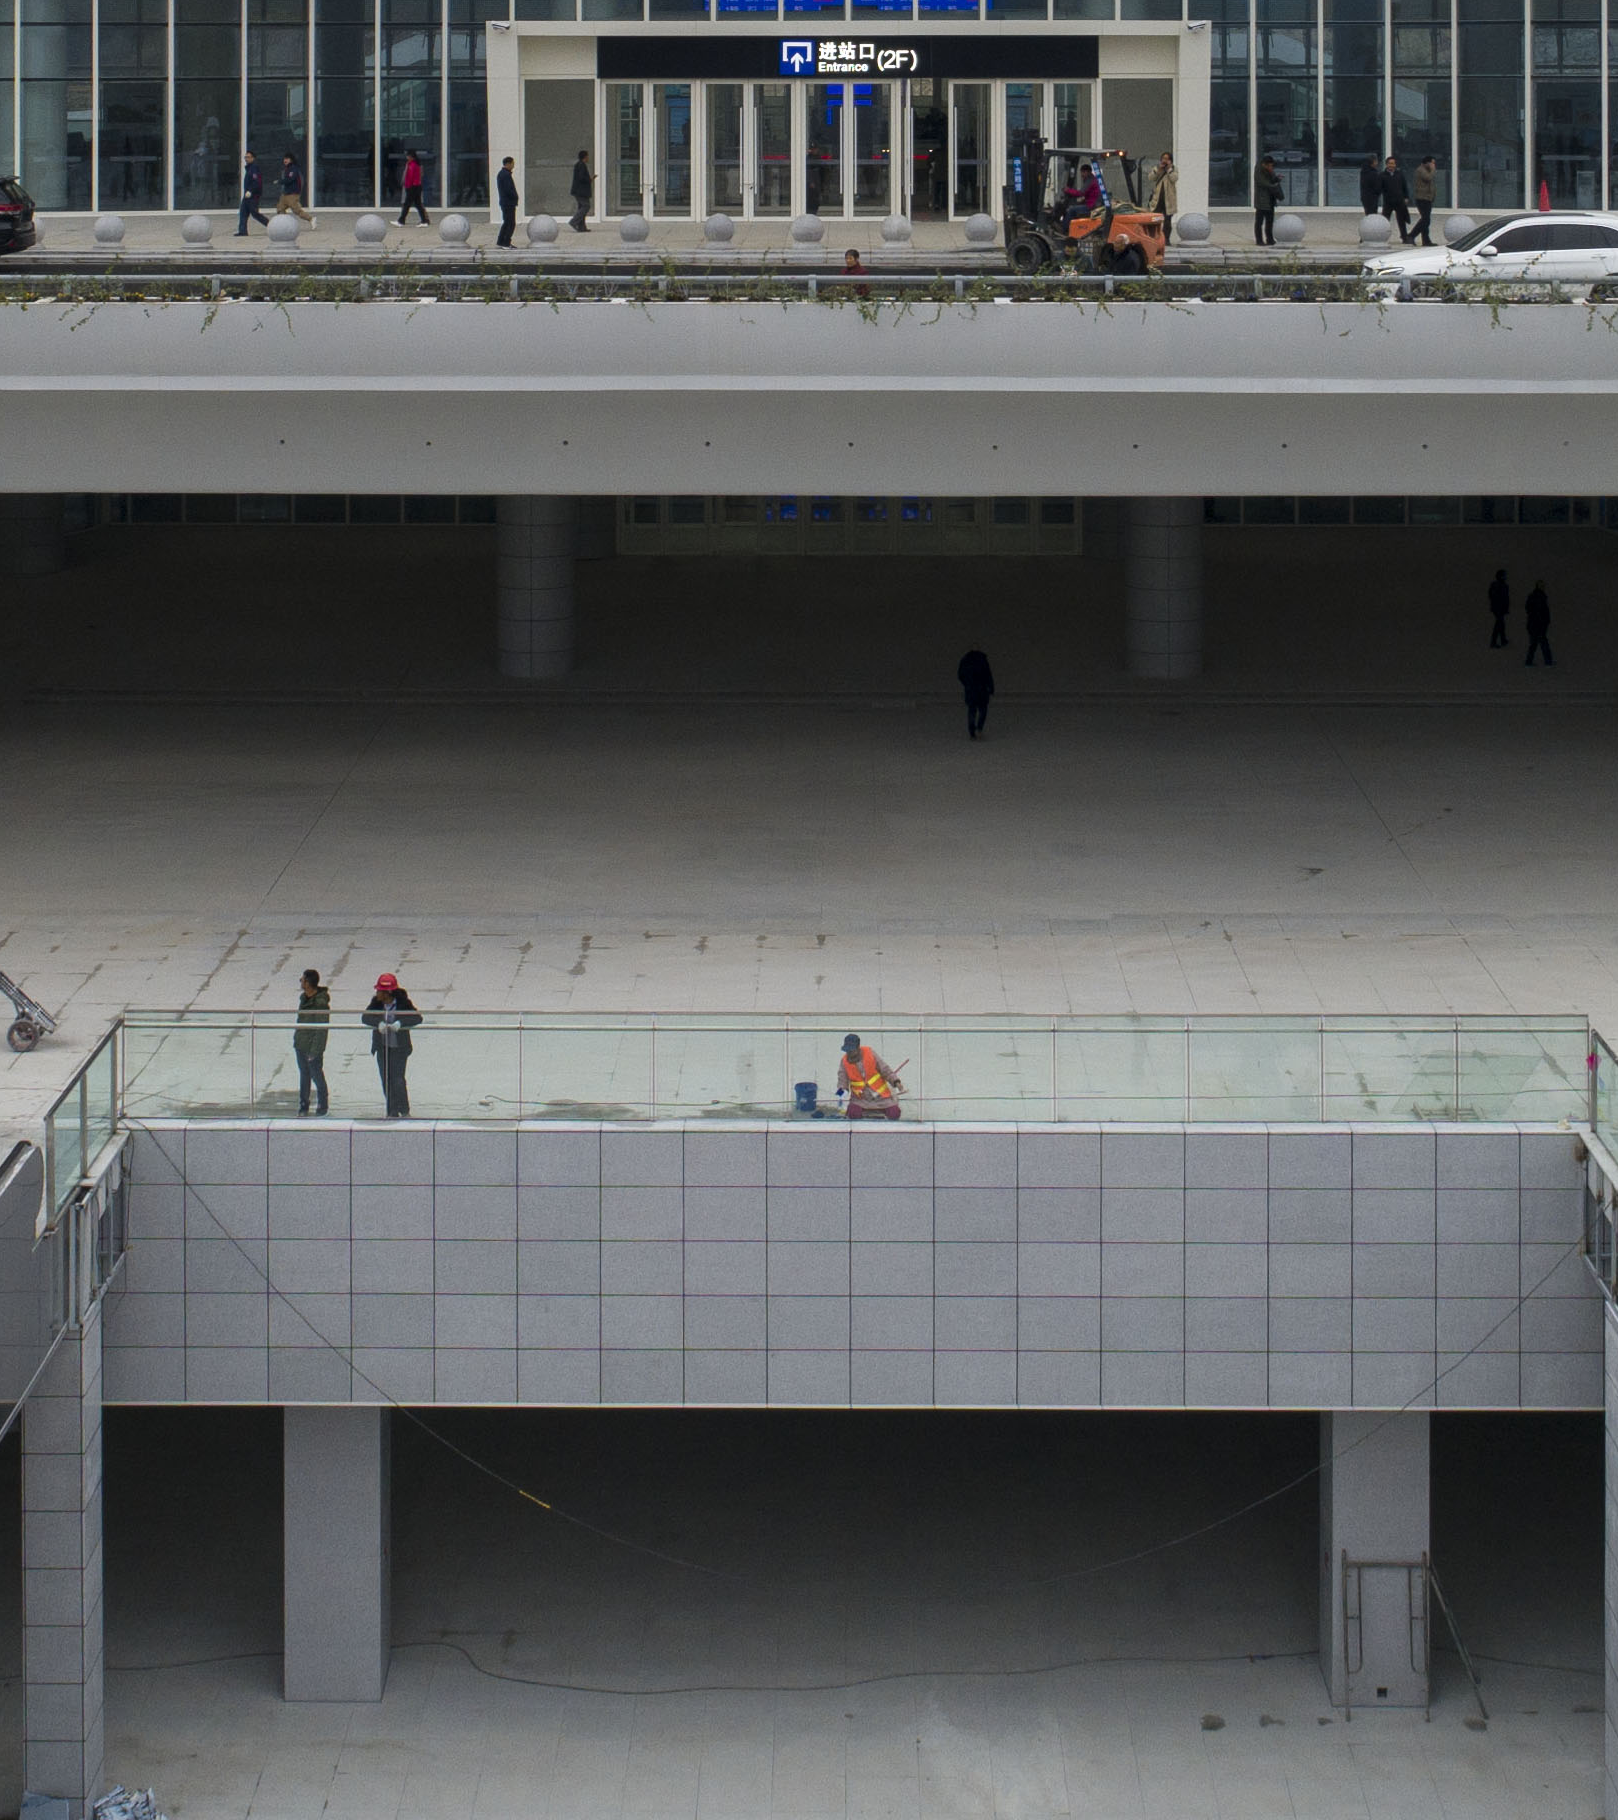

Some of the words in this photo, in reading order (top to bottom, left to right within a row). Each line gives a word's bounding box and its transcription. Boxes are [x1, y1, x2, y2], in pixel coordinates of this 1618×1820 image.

[817, 61, 871, 72] Entrance
[818, 41, 875, 60] 进站口
[876, 49, 916, 72] (2F)
